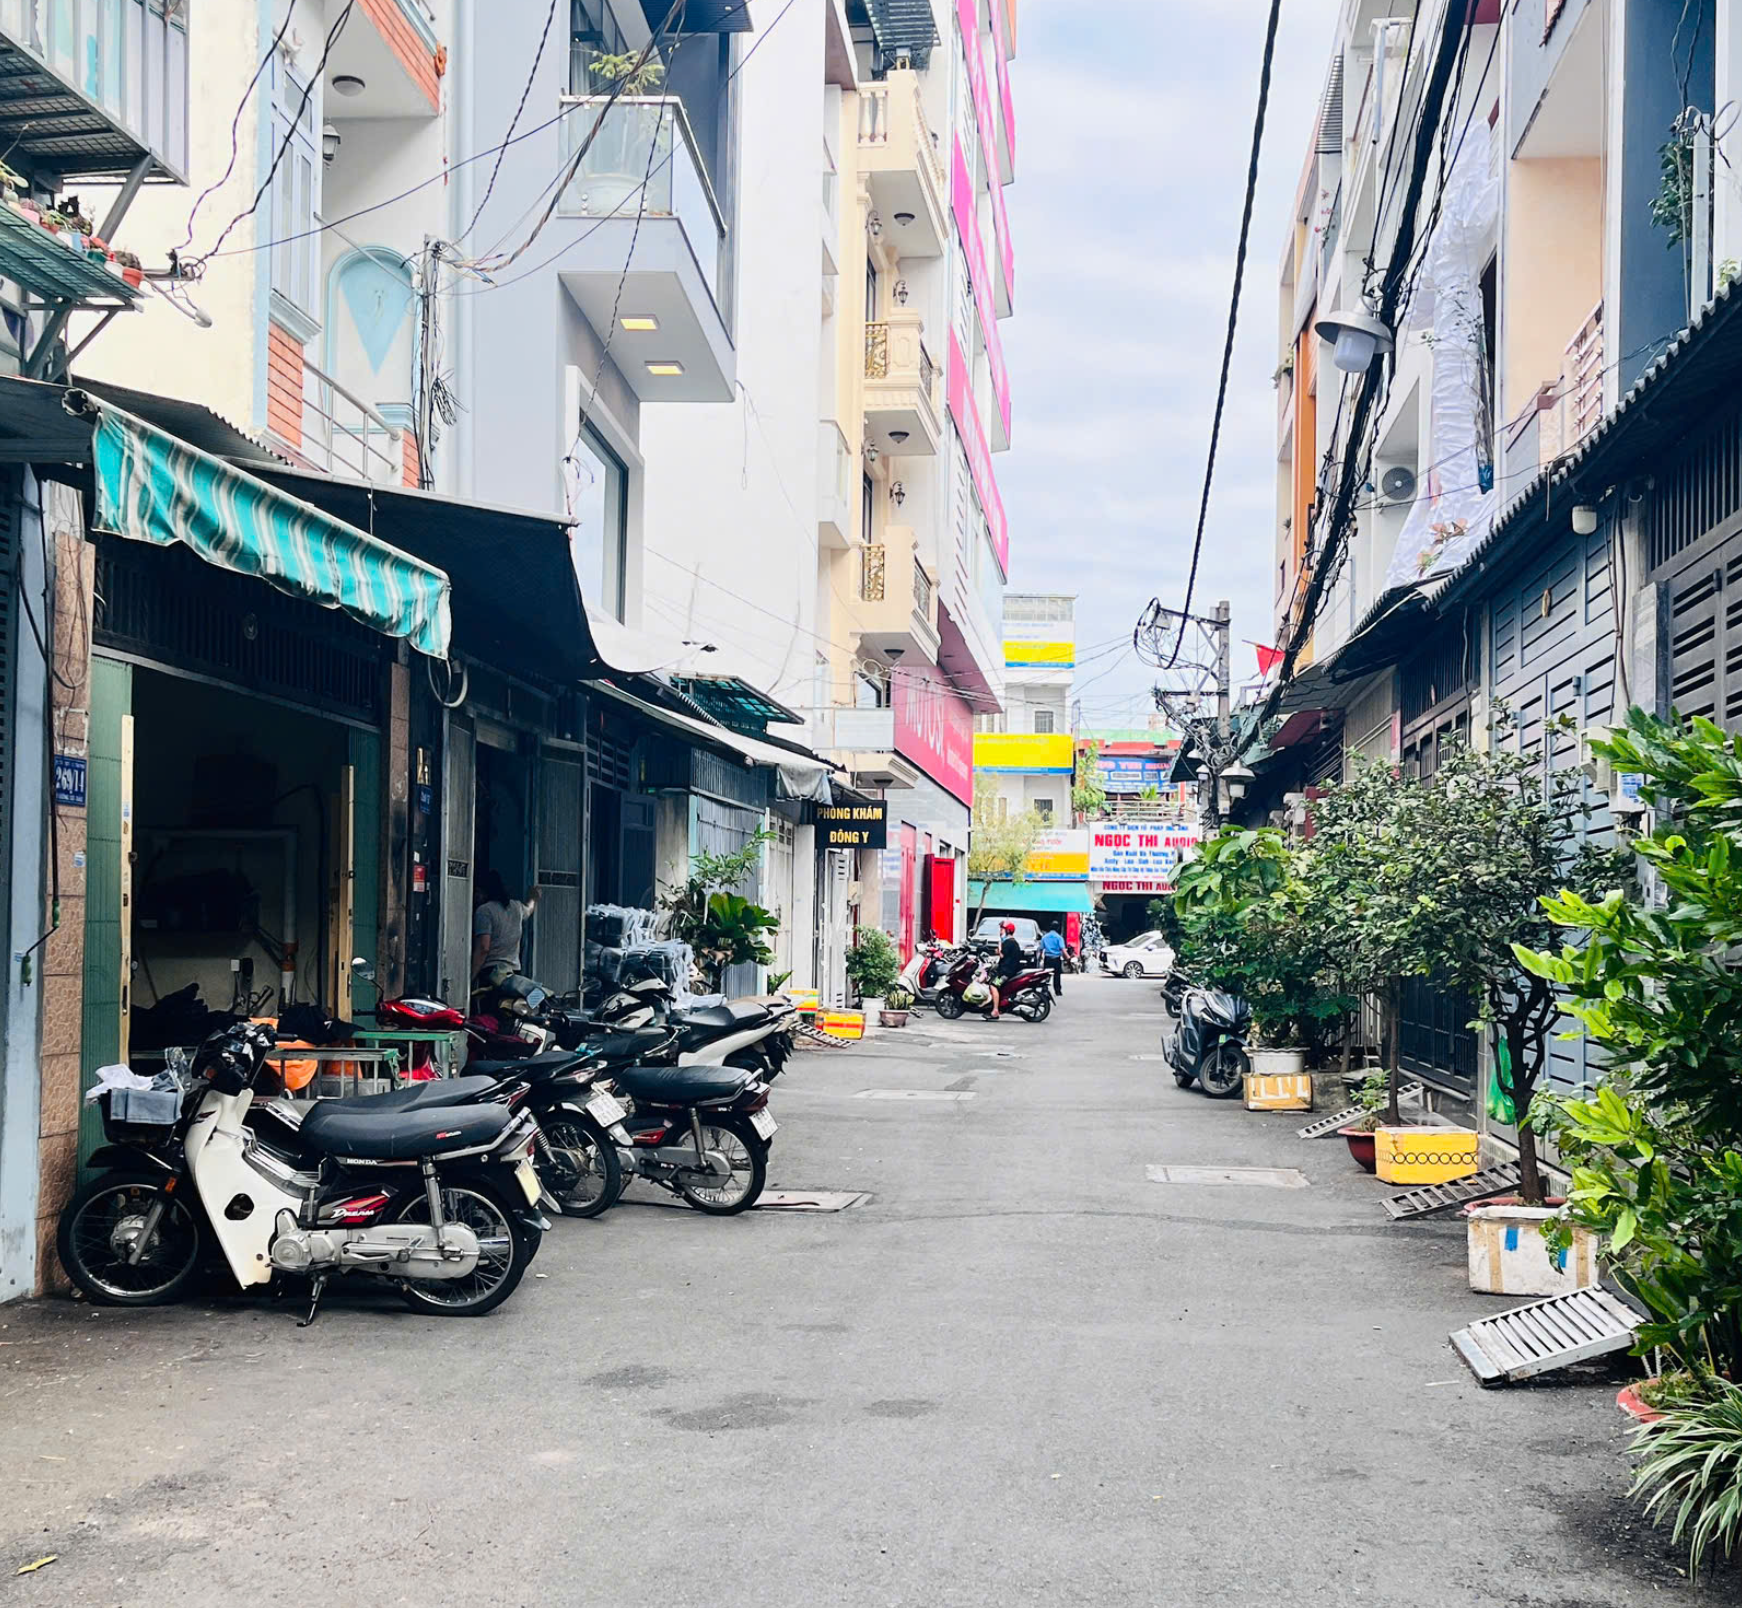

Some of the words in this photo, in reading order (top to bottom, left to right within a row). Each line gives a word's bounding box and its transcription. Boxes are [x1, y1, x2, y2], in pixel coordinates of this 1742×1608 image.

[861, 831, 870, 844] Y
[1094, 834, 1131, 850] NGỌC
[1137, 834, 1159, 848] THI
[1136, 881, 1153, 891] THI
